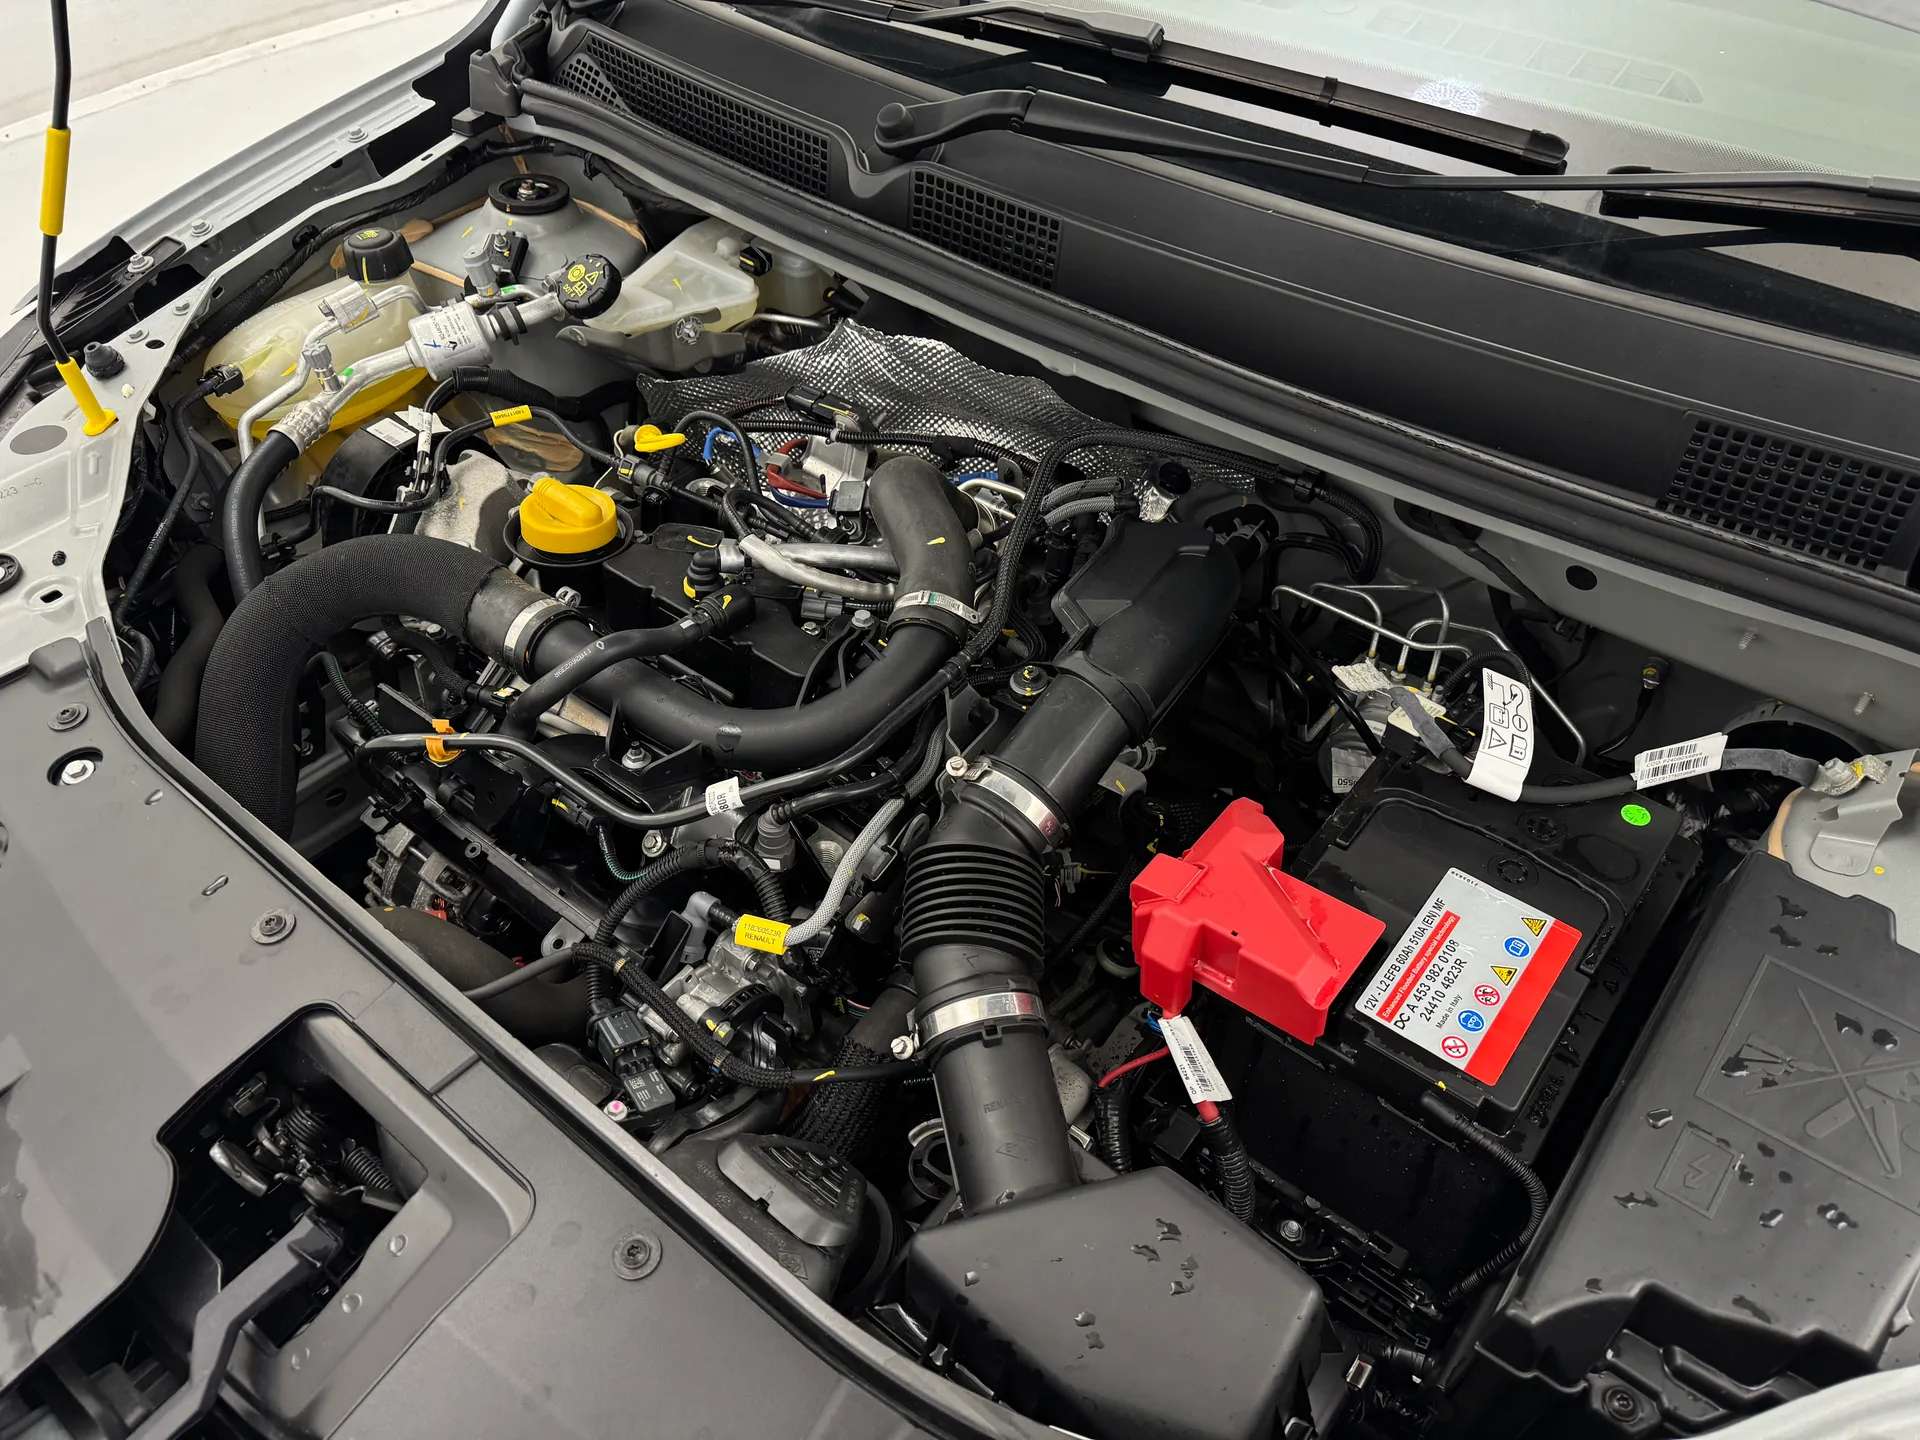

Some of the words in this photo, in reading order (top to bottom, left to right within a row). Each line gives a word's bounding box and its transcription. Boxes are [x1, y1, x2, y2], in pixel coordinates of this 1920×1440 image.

[745, 932, 776, 945] RENAULT
[1363, 994, 1379, 1011] 12V
[1376, 980, 1390, 993] L2
[1384, 963, 1401, 982] EFB
[1395, 945, 1415, 965] 60Ah
[1409, 926, 1428, 947] 510A
[1422, 911, 1441, 929] (EN)
[1432, 897, 1446, 912] MF
[1382, 992, 1403, 1018] Enhanced
[1400, 970, 1417, 994] Flooded
[1412, 956, 1428, 976] Battery
[1424, 939, 1439, 958] special
[1435, 915, 1456, 941] technology
[1393, 1012, 1411, 1030] DC
[1407, 1002, 1418, 1014] A
[1413, 983, 1431, 1002] 453
[1425, 963, 1444, 983] 982
[1438, 939, 1460, 964] 0108
[1420, 990, 1446, 1022] 24410
[1442, 957, 1468, 990] 4823R
[1436, 1013, 1449, 1029] Made
[1452, 994, 1463, 1008] Italy
